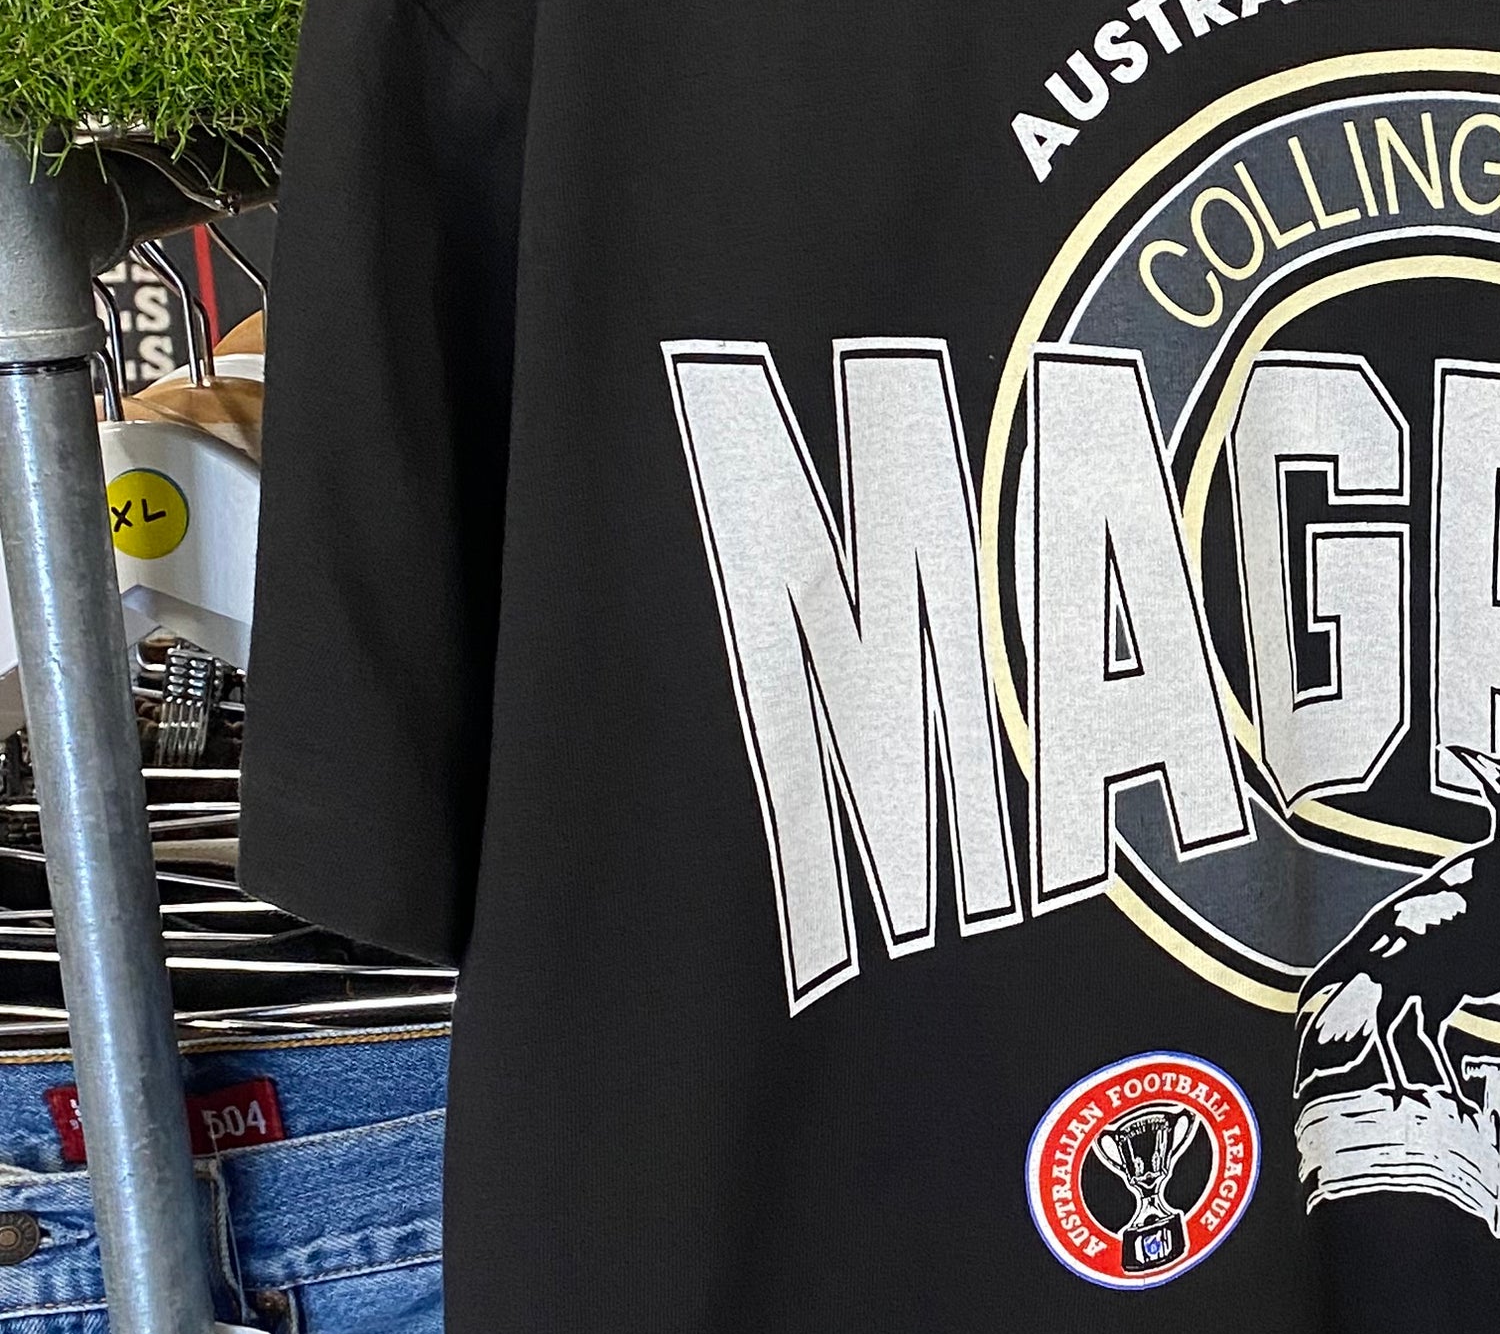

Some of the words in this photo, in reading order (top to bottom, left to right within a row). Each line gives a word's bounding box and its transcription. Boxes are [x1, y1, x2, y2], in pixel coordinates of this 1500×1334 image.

[111, 499, 166, 532] XL
[201, 1100, 266, 1139] 504
[1052, 1102, 1107, 1257] AUSTRALIAN
[1105, 1072, 1230, 1122] FOOTBALL
[1200, 1124, 1244, 1232] LEAGUE
